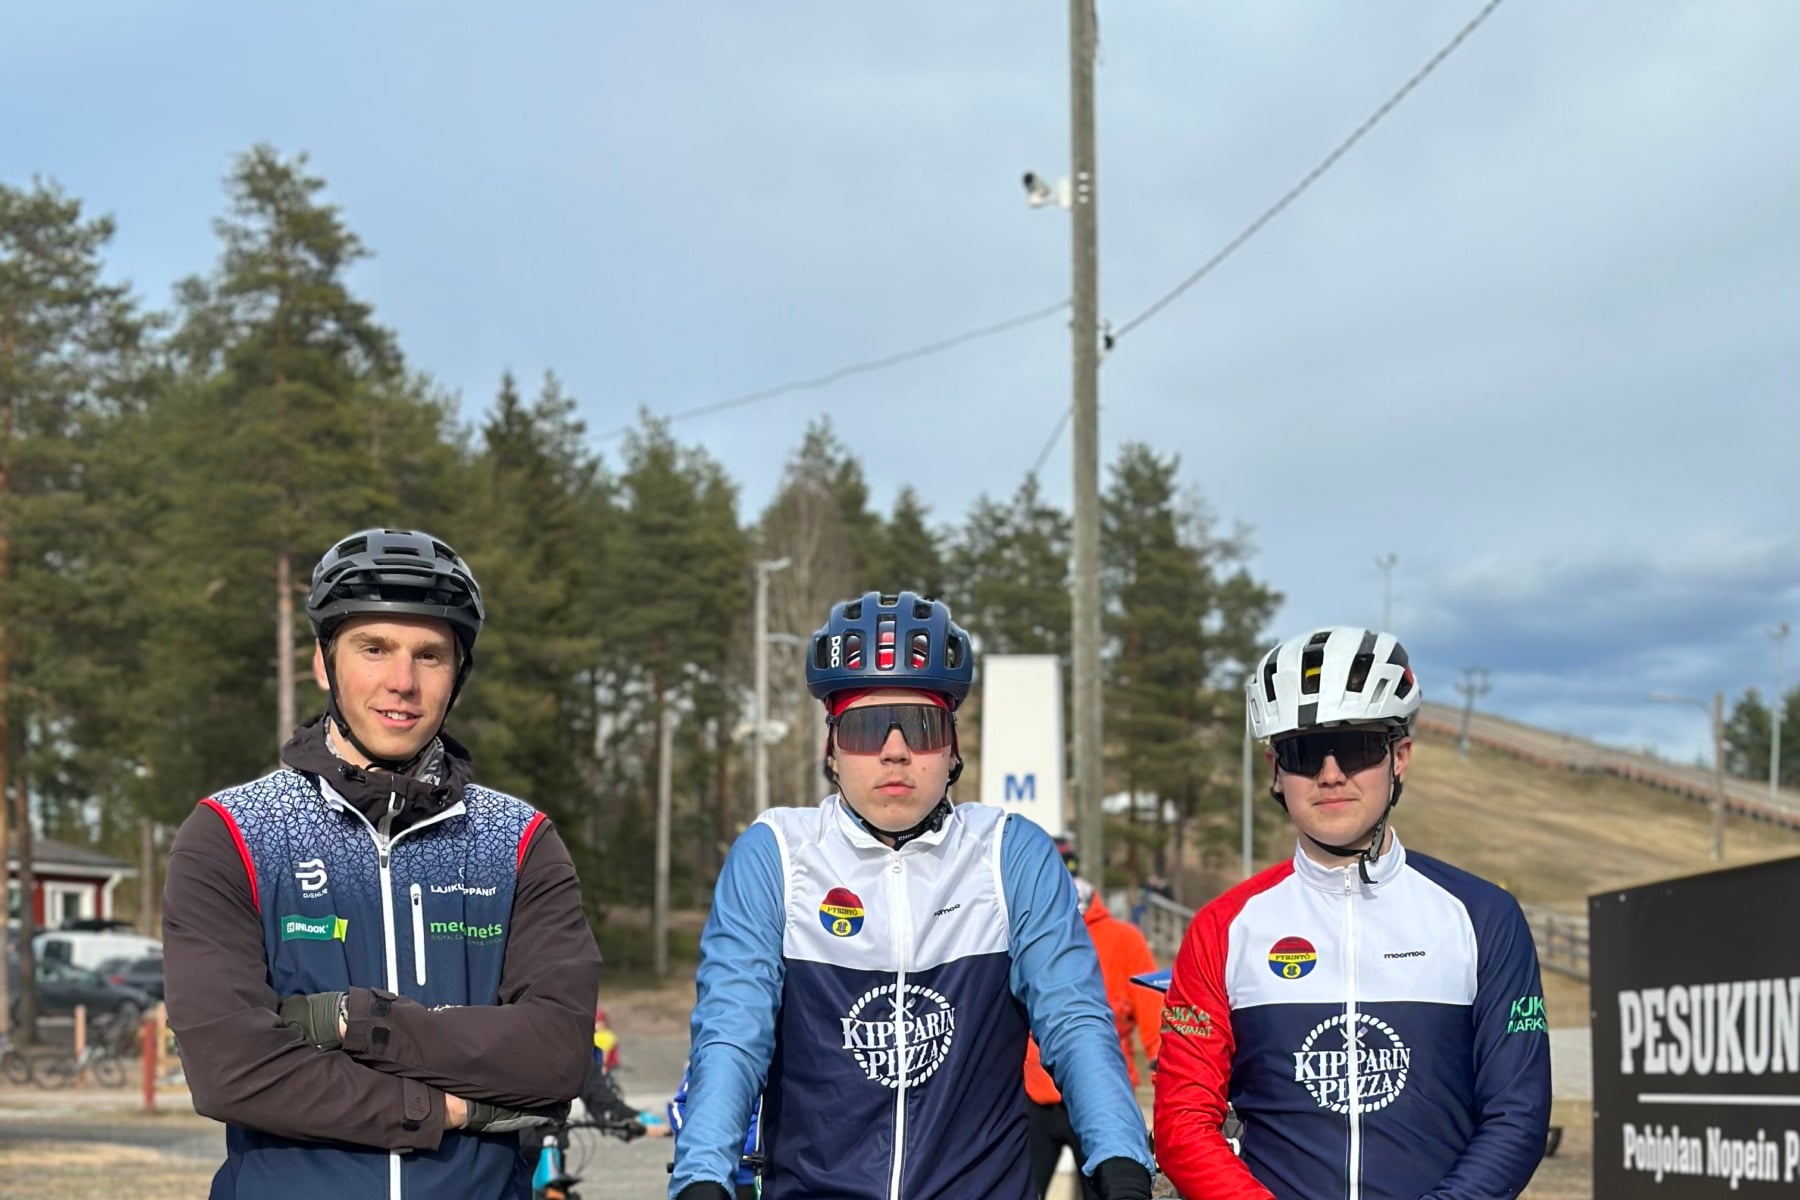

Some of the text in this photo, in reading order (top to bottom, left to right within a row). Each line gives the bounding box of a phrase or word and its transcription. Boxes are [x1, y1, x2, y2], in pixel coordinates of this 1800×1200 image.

[1004, 774, 1035, 802] M
[839, 1007, 956, 1050] KIPPARIN
[1618, 975, 1800, 1075] PESUKUN
[866, 1039, 939, 1081] PIZZA
[1292, 1047, 1411, 1082] KIPPARIN
[1317, 1072, 1394, 1108] PIZZA
[1622, 1122, 1704, 1183] Pohjolan
[1706, 1126, 1779, 1190] Nopein
